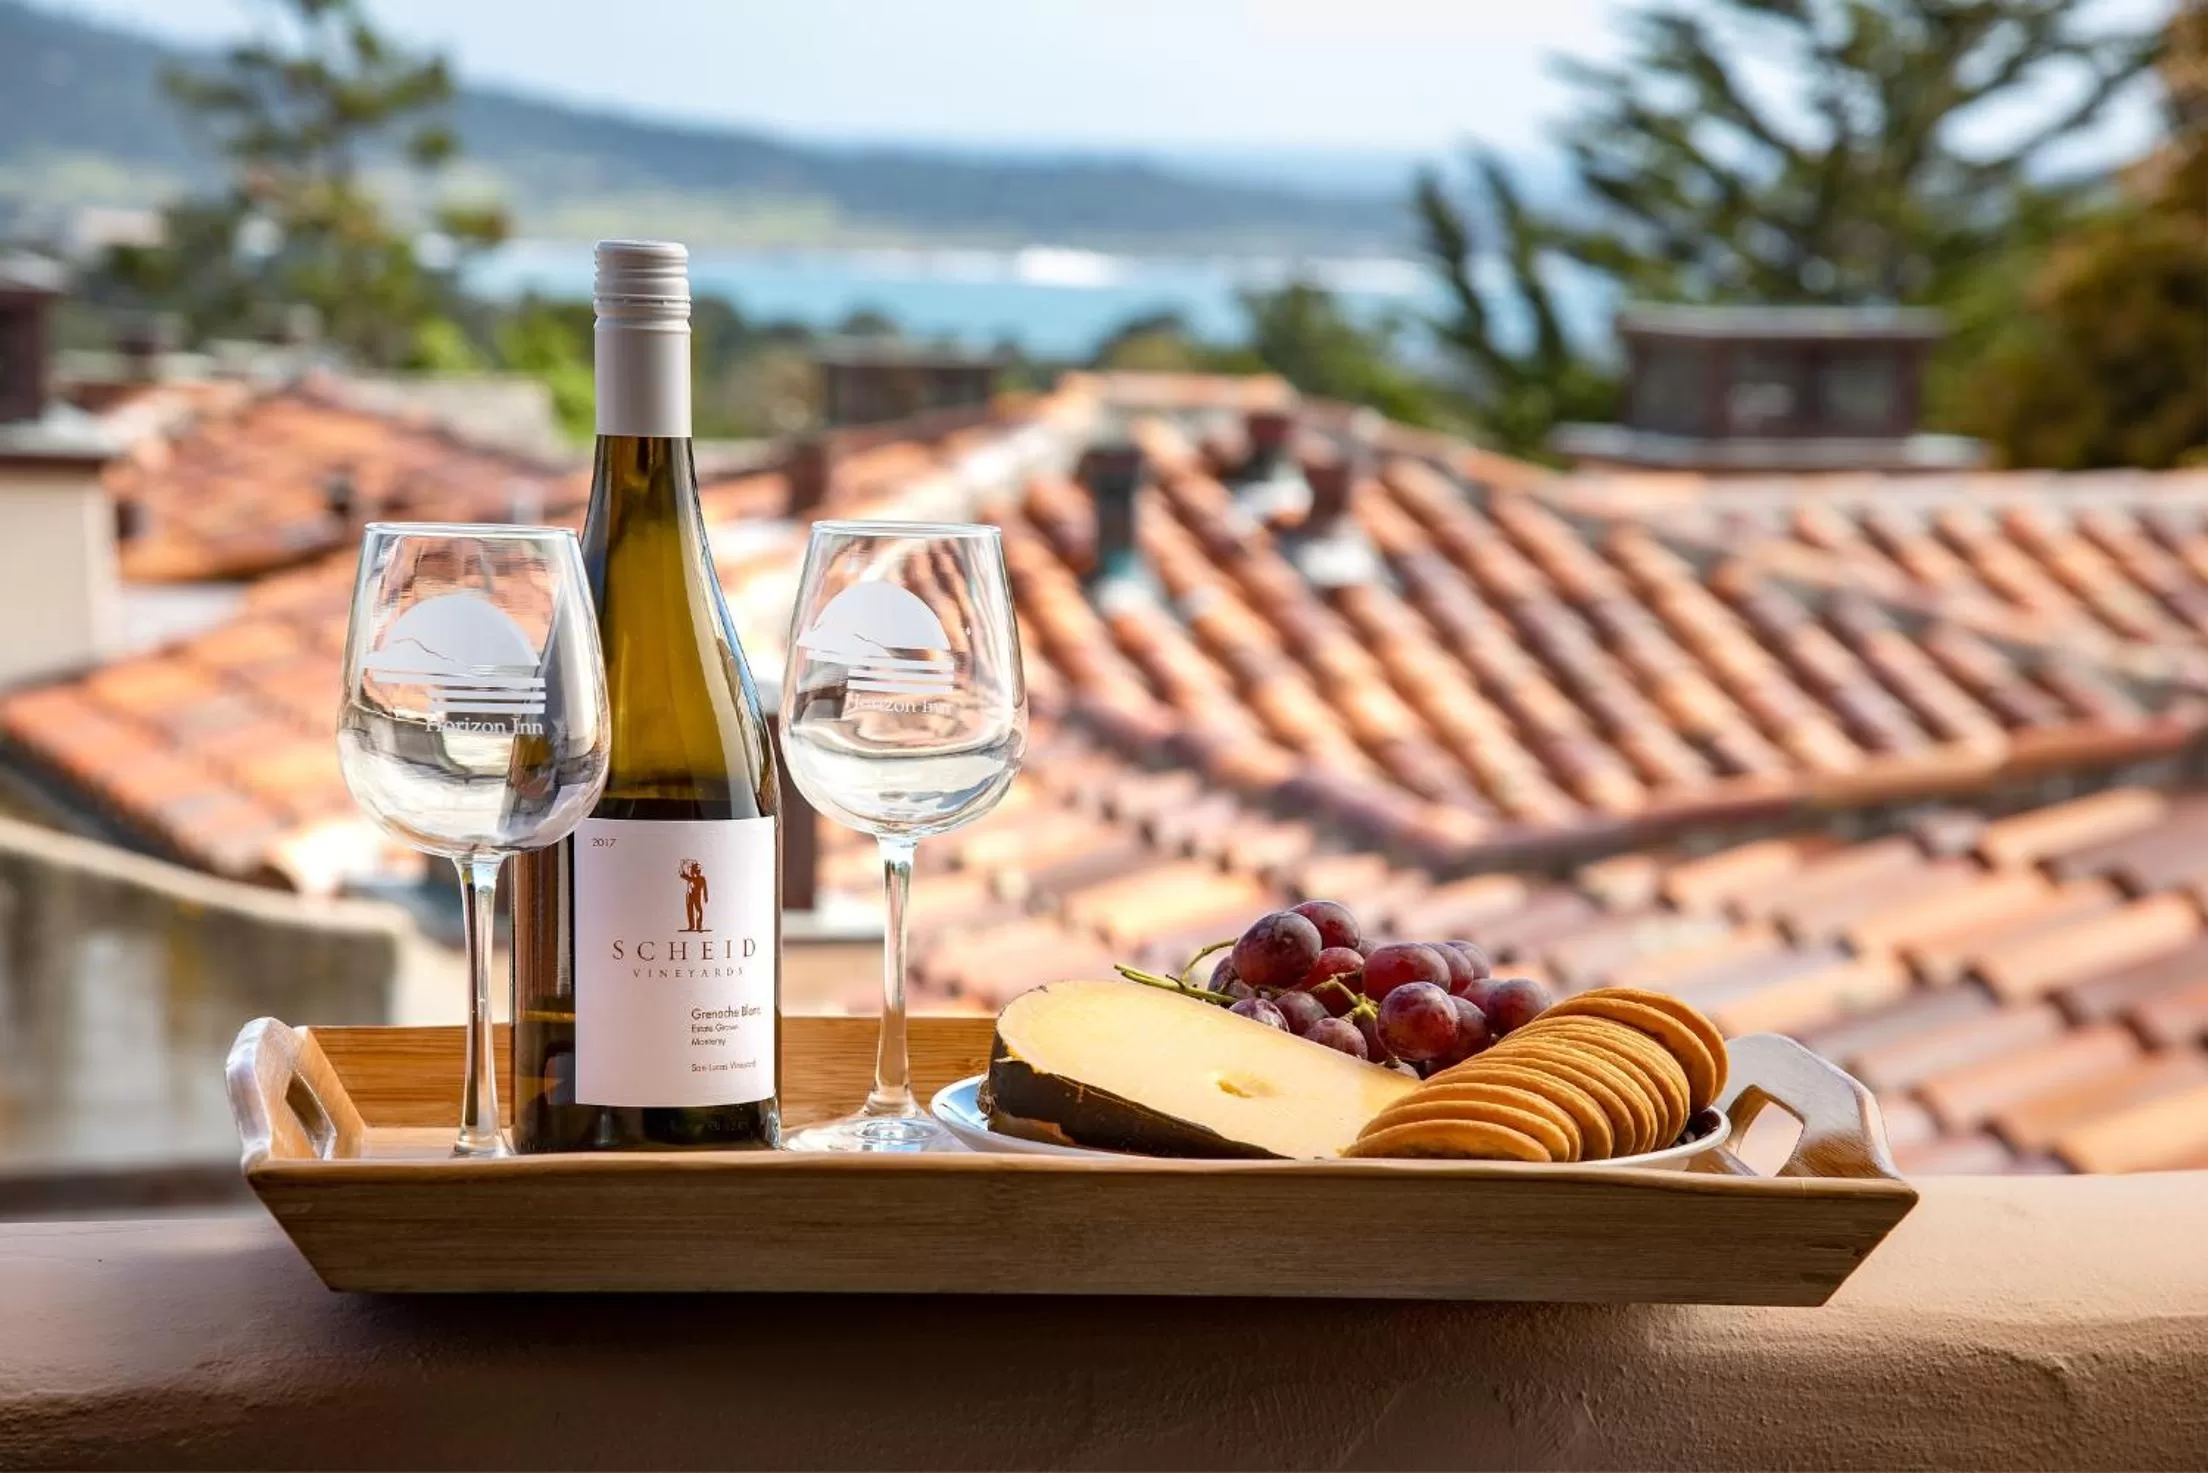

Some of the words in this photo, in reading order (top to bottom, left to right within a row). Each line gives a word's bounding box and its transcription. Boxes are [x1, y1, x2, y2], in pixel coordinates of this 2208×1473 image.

[846, 692, 917, 713] Hzon
[425, 714, 507, 734] Horizon
[512, 715, 544, 735] Inn
[592, 838, 616, 847] 2017
[612, 938, 757, 961] SCHEID
[633, 967, 744, 978] VINEYARDS
[691, 1005, 740, 1020] Grenache
